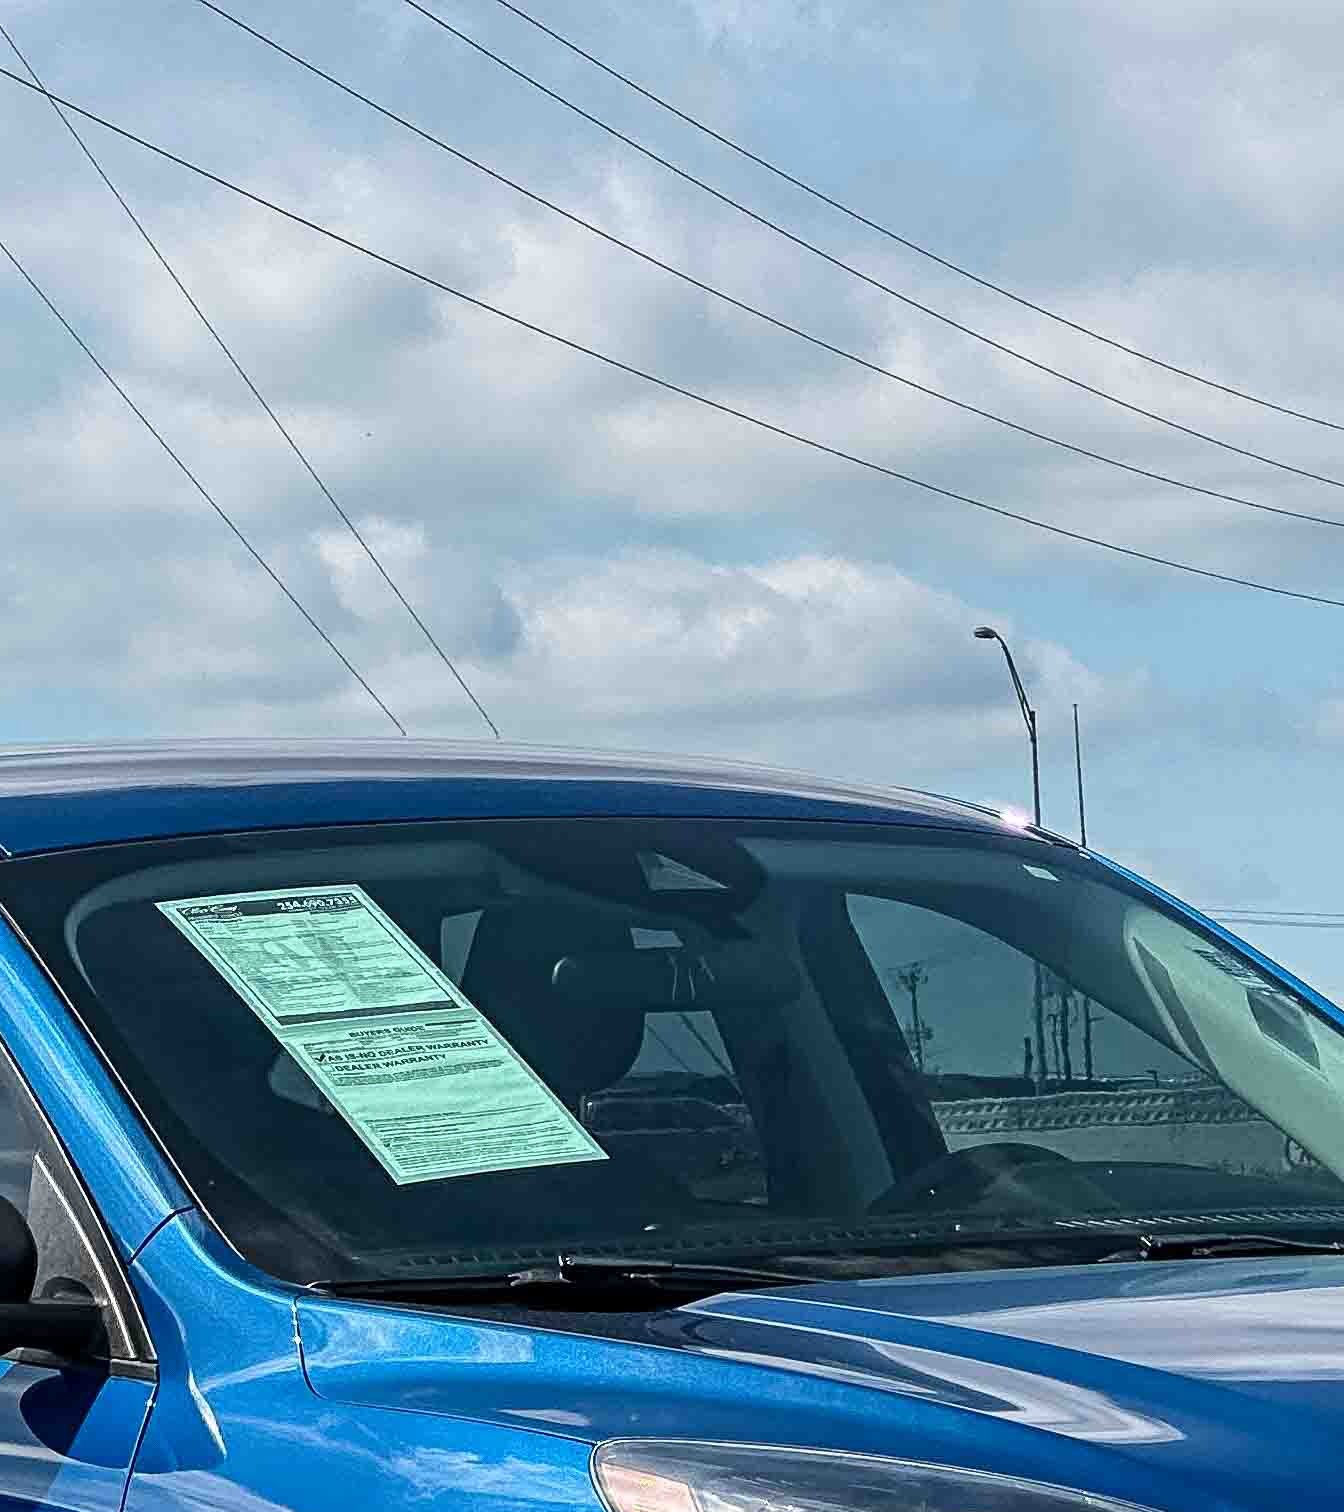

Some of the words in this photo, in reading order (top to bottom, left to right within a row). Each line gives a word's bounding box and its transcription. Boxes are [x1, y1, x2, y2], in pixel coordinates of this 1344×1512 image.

[377, 1043, 425, 1058] DEALER
[425, 1038, 490, 1052] WARRANTY
[334, 1061, 381, 1072] DEALER
[381, 1053, 447, 1069] WARRANTY
